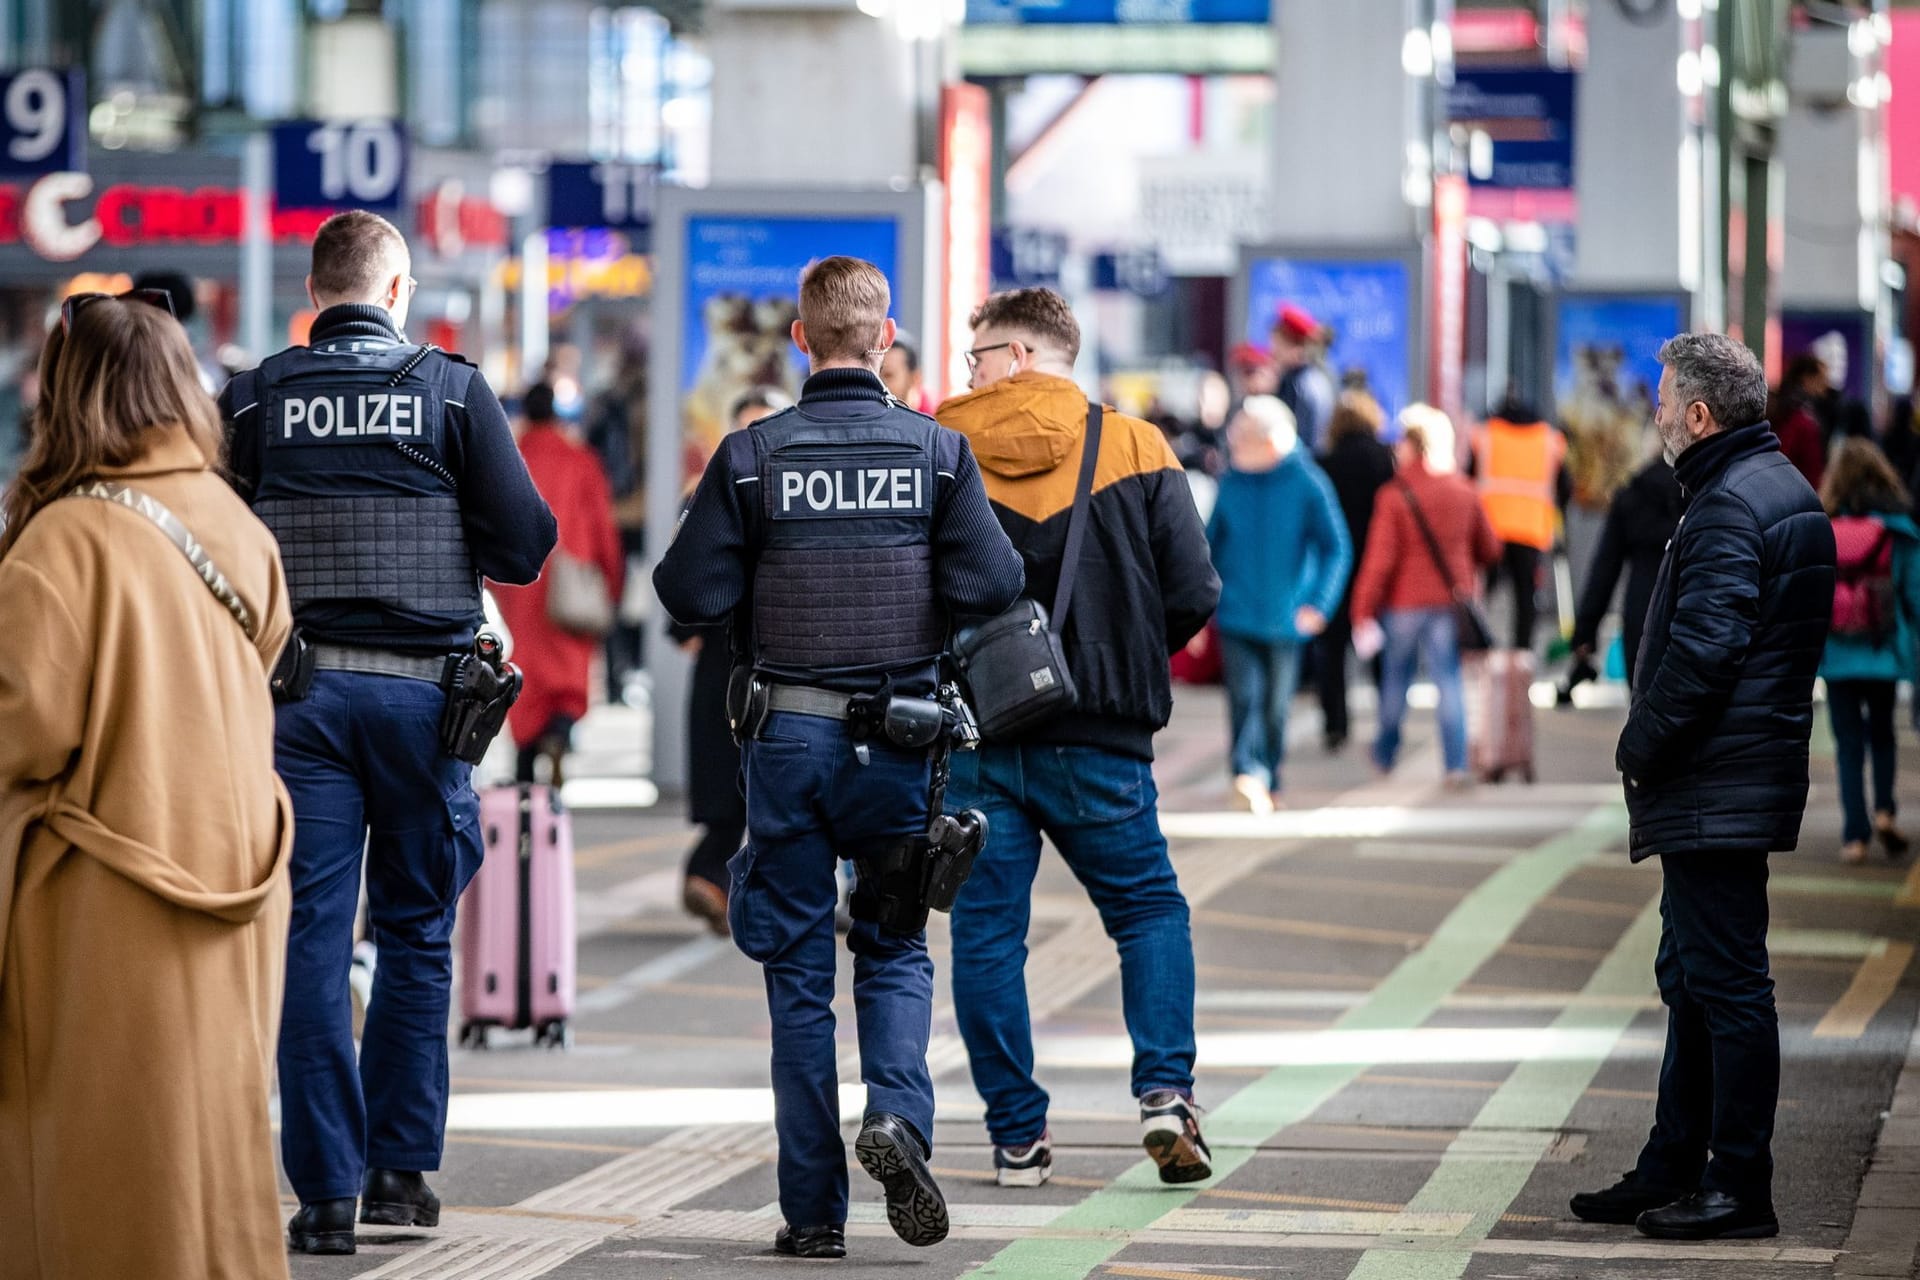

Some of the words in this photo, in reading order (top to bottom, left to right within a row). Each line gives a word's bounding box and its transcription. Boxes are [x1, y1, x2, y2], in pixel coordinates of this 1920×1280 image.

[5, 69, 66, 161] 9
[306, 121, 399, 201] 10
[283, 394, 423, 439] POLIZEI
[782, 468, 922, 512] POLIZEI
